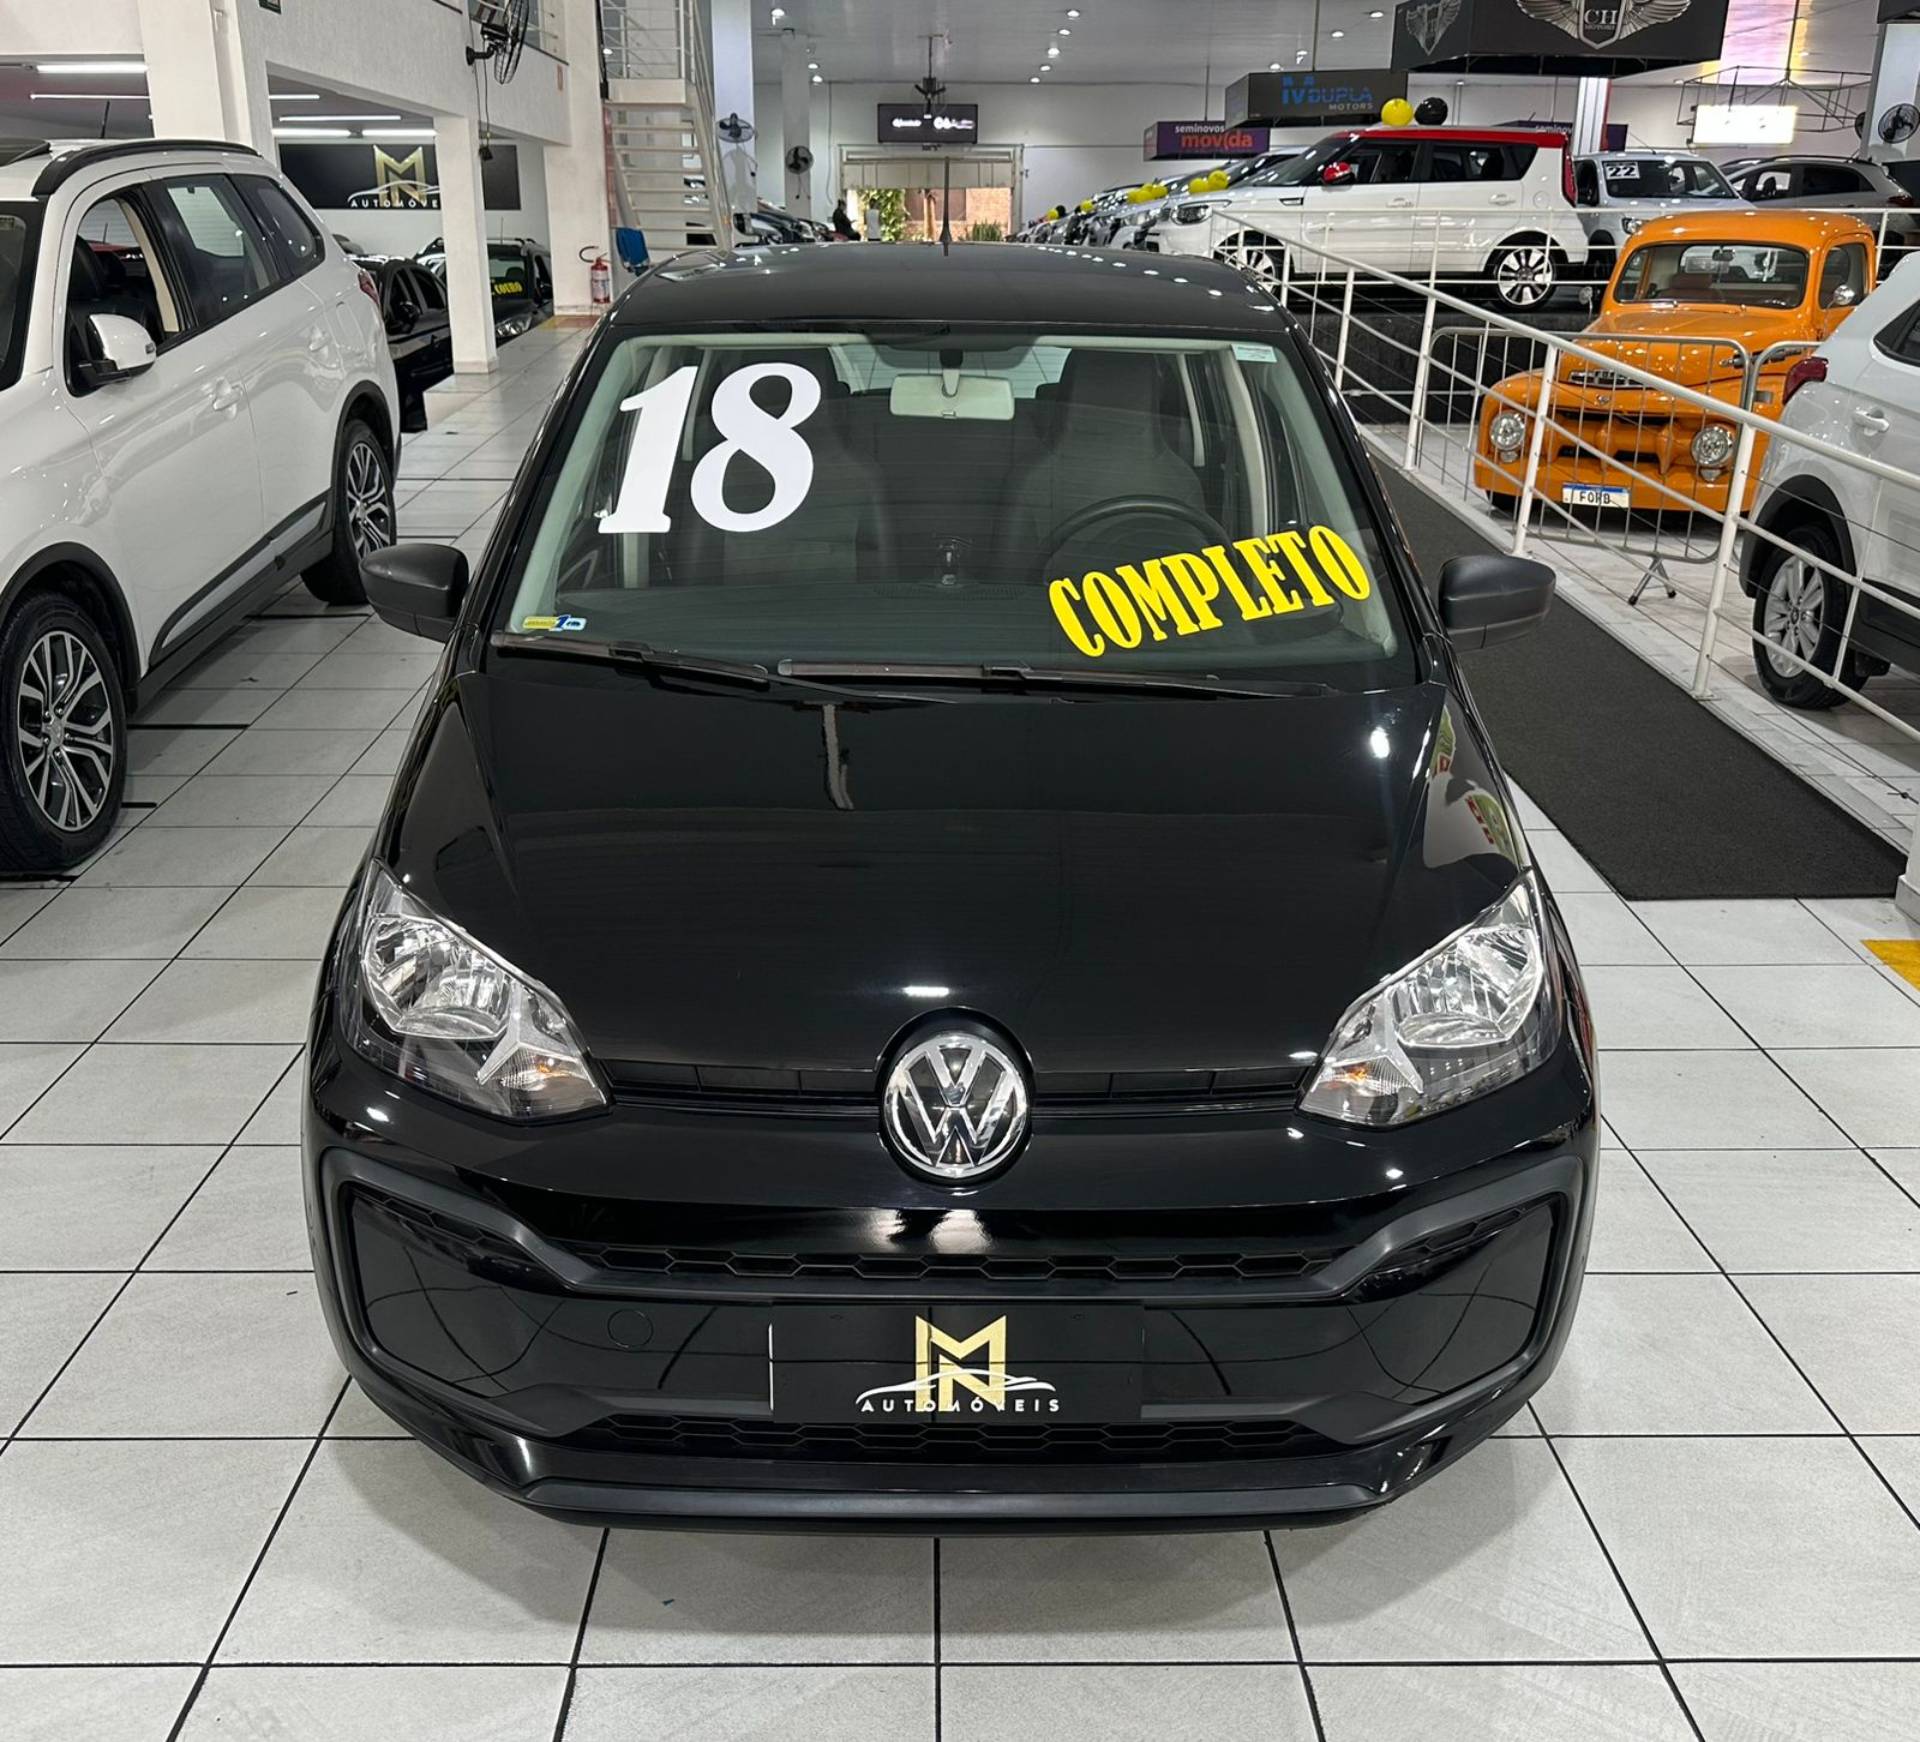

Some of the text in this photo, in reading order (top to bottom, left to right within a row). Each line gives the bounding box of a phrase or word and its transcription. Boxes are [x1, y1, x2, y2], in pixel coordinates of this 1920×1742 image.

[1584, 9, 1618, 25] CH
[1328, 102, 1374, 110] MOTORS
[1175, 123, 1225, 134] seminovos
[1608, 166, 1636, 177] 22
[596, 362, 821, 533] 18
[1049, 525, 1370, 657] COMPLETO
